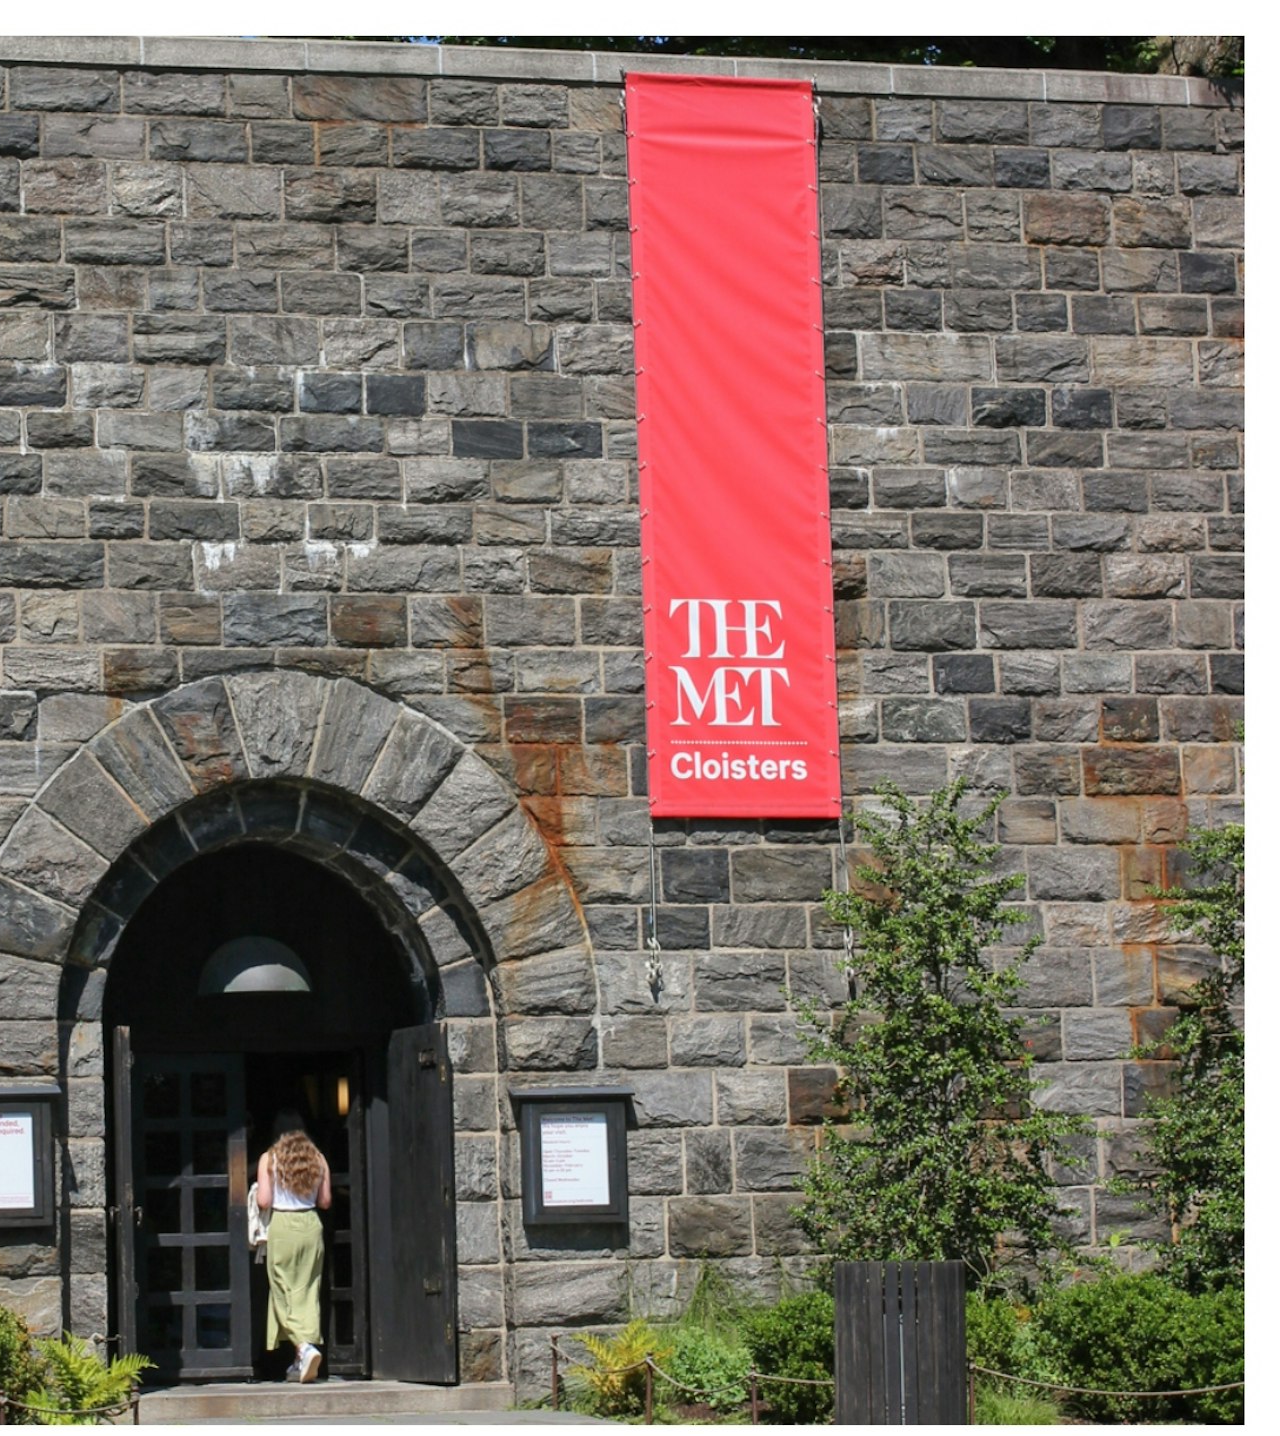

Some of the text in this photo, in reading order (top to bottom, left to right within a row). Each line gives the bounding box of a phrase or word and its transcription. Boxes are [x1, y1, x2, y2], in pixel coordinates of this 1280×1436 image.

[668, 598, 786, 660] THE
[668, 665, 790, 726] MET
[670, 751, 808, 780] Cloisters
